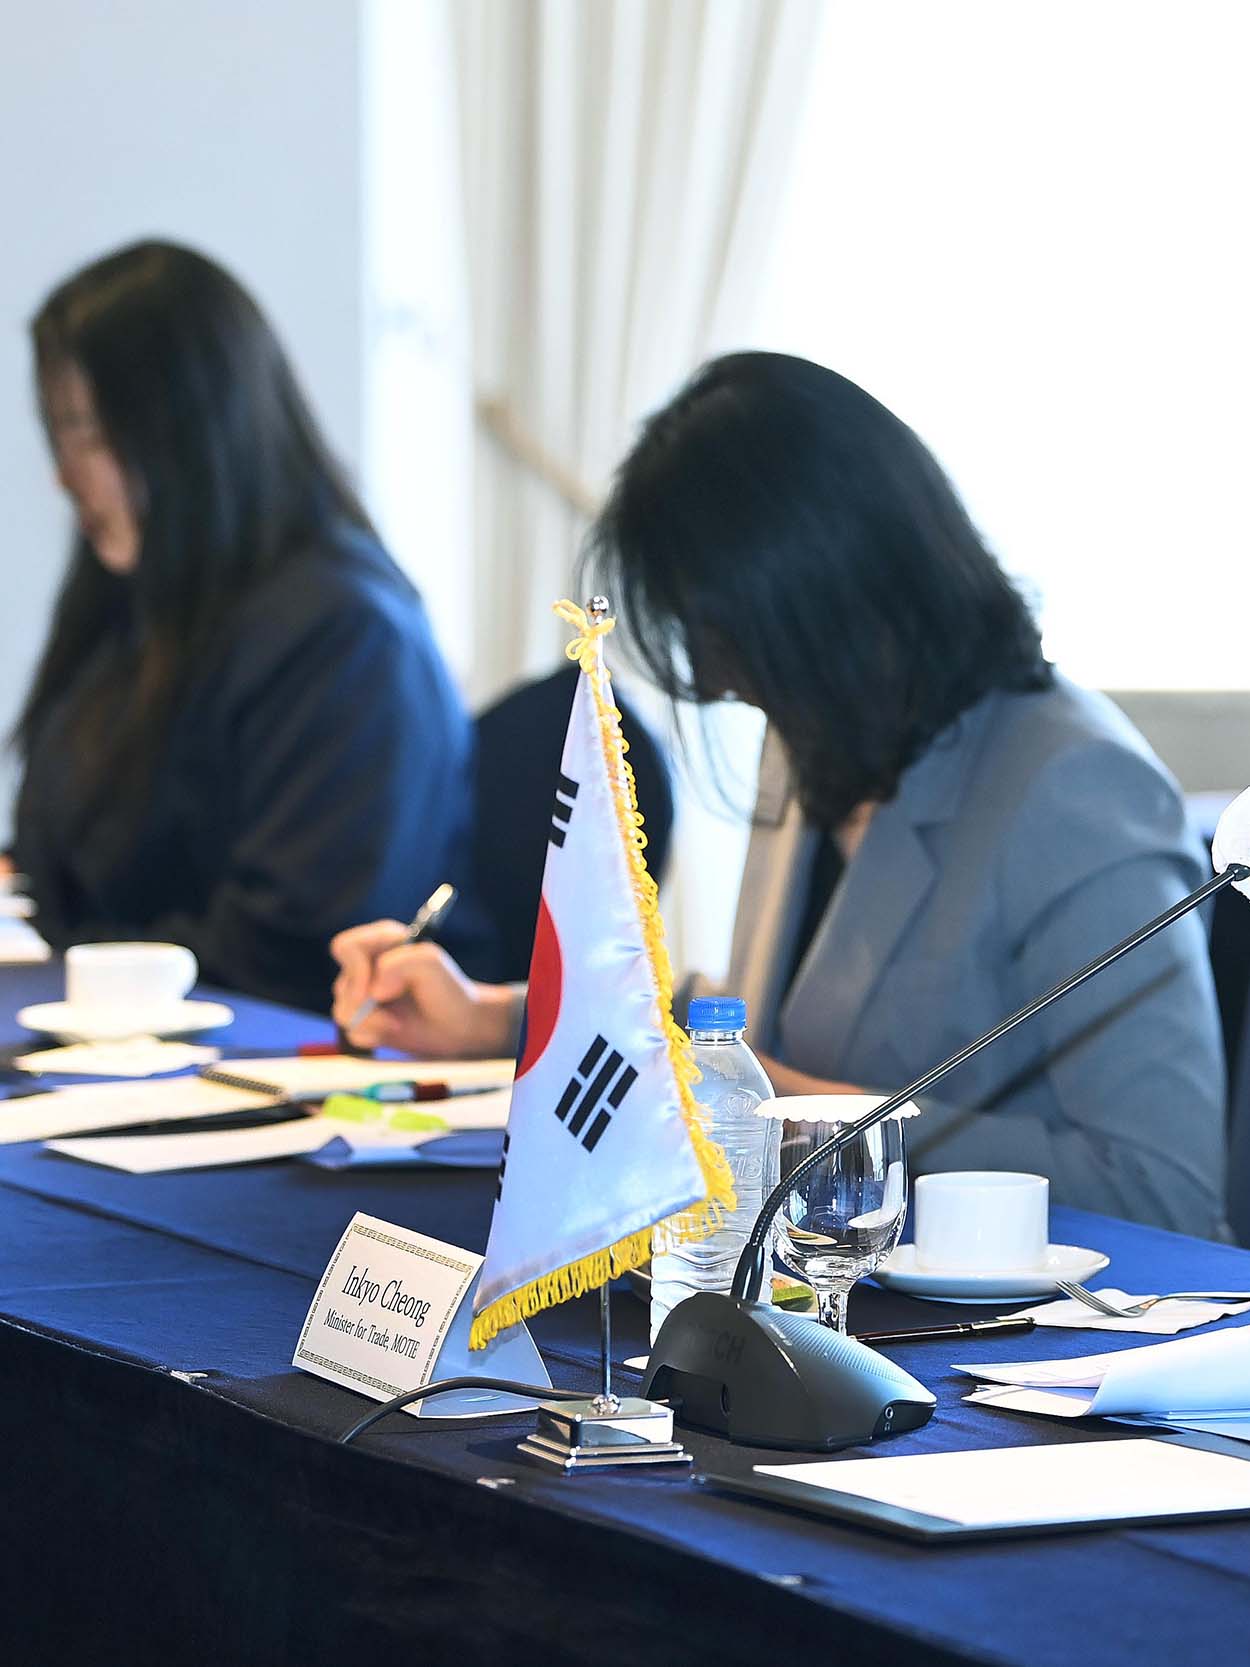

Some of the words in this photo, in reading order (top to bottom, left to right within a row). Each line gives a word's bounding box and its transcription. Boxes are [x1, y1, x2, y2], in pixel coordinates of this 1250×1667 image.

[341, 1265, 380, 1306] Inkyo
[380, 1279, 432, 1328] Cheong
[323, 1308, 356, 1337] Minister
[353, 1318, 368, 1340] for
[368, 1324, 390, 1352] Trade,
[390, 1333, 421, 1360] MOTIE
